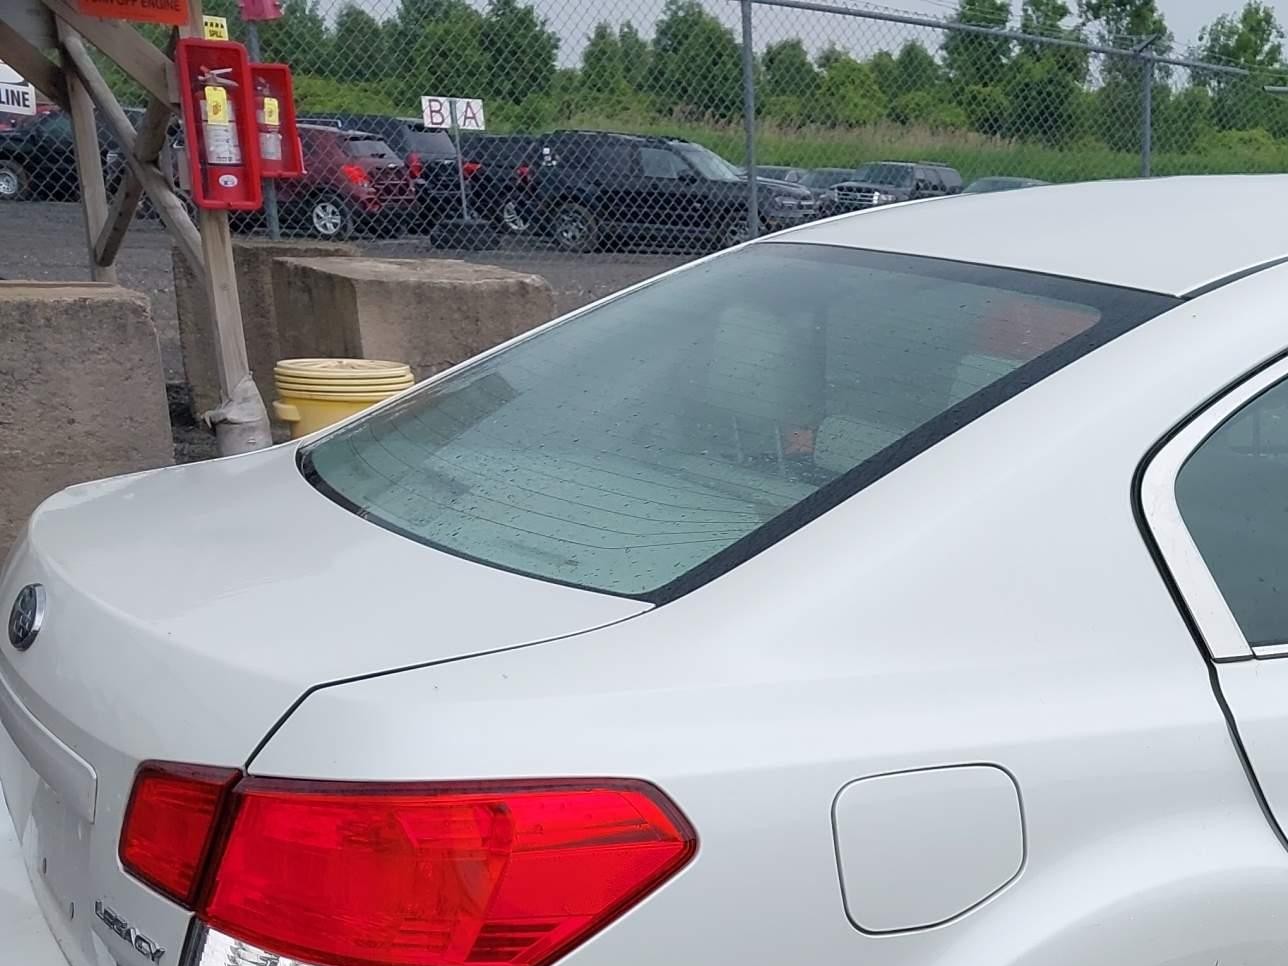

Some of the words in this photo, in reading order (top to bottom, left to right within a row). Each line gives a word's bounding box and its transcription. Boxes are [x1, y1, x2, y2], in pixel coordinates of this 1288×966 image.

[141, 0, 181, 11] ENGINE
[428, 99, 445, 126] B
[462, 101, 480, 128] A
[94, 899, 167, 966] LEGACY
